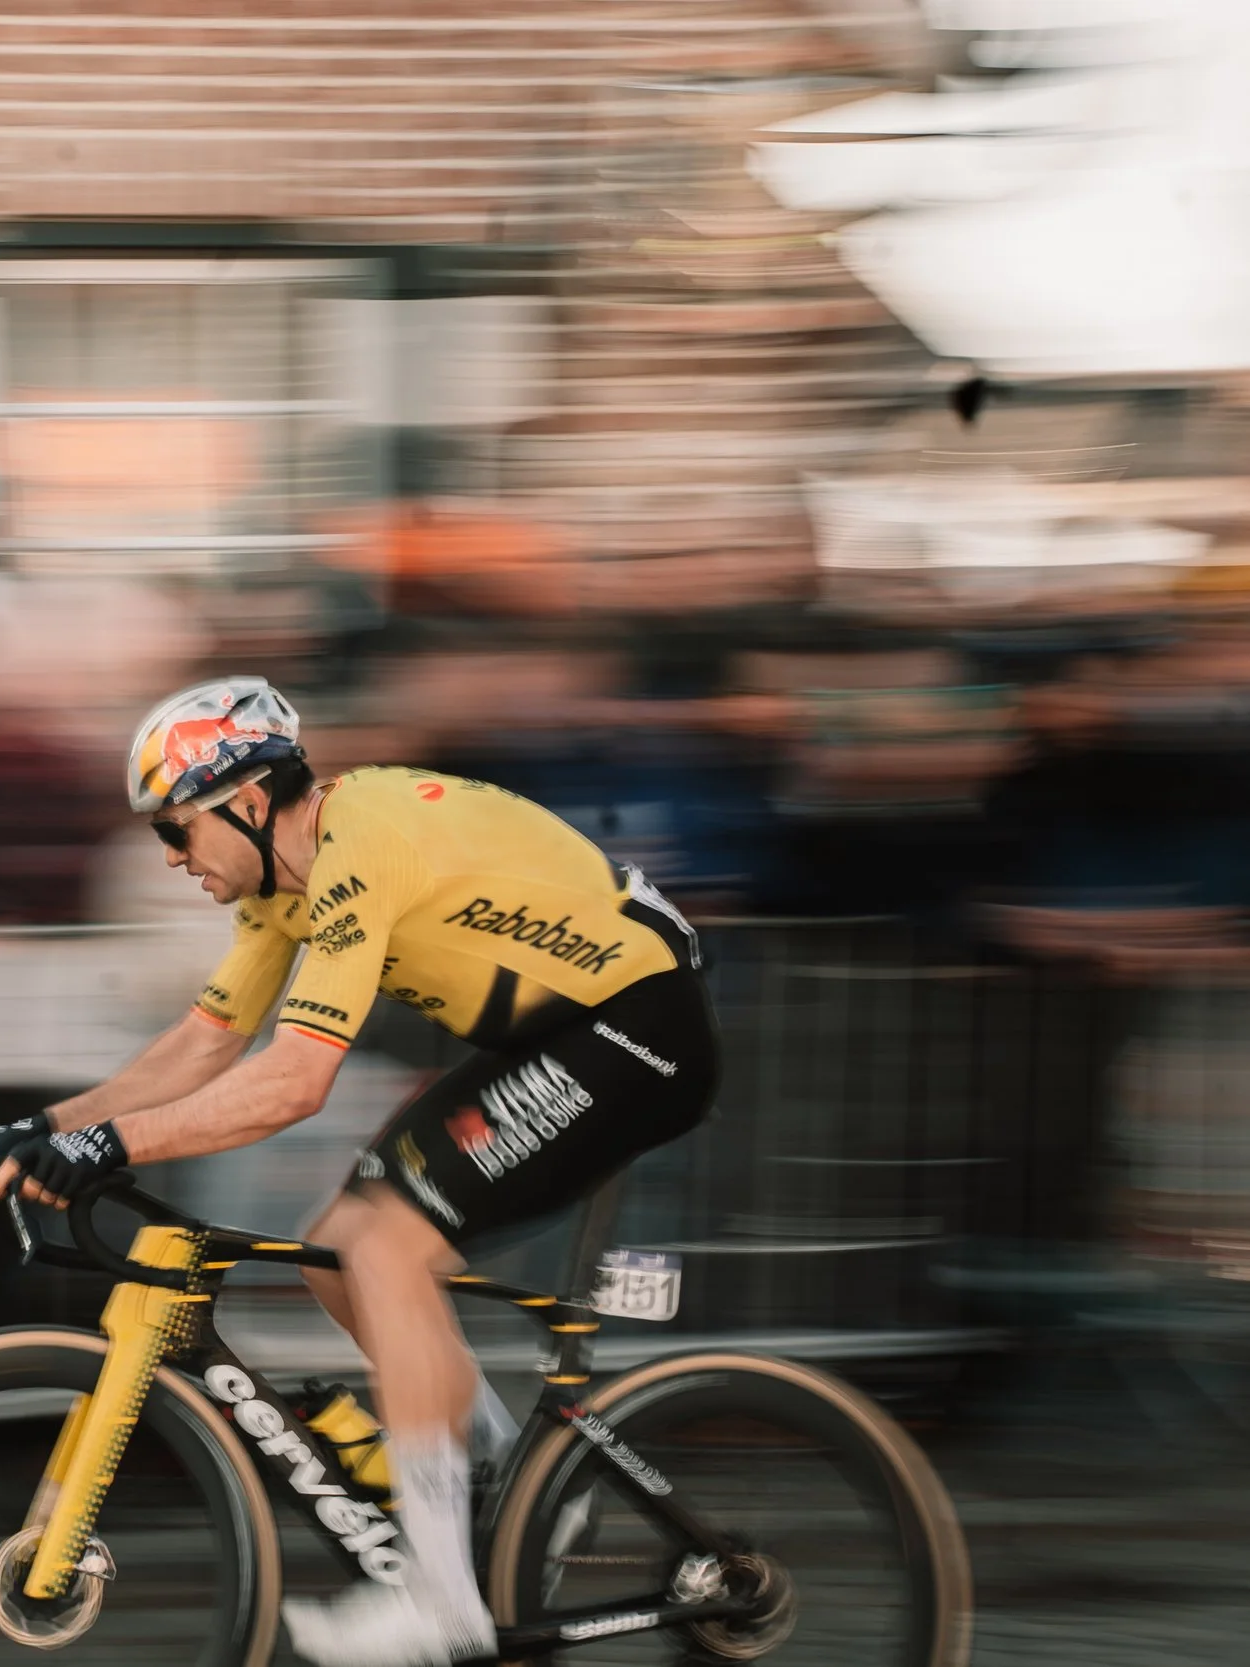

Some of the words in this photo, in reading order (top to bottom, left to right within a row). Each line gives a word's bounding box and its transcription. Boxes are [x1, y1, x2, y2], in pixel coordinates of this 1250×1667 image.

[313, 912, 358, 943] ease
[443, 897, 625, 975] Rabobank
[479, 1052, 576, 1131] VISMA
